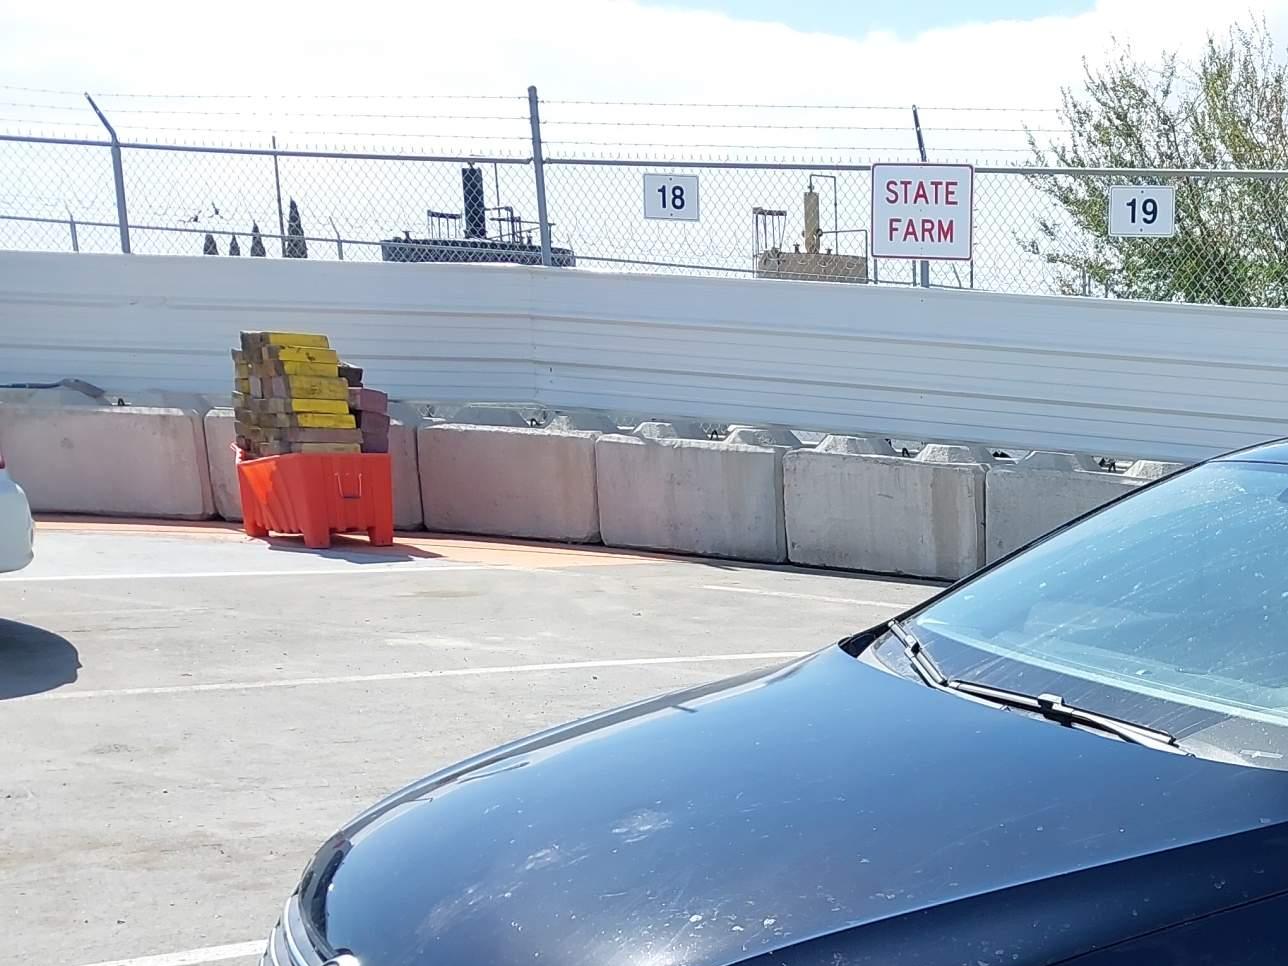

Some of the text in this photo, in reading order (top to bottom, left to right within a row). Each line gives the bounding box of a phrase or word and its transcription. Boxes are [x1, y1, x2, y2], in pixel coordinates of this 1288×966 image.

[656, 184, 686, 210] 18
[885, 180, 959, 206] STATE
[1125, 197, 1159, 225] 19
[888, 218, 955, 243] FARM
